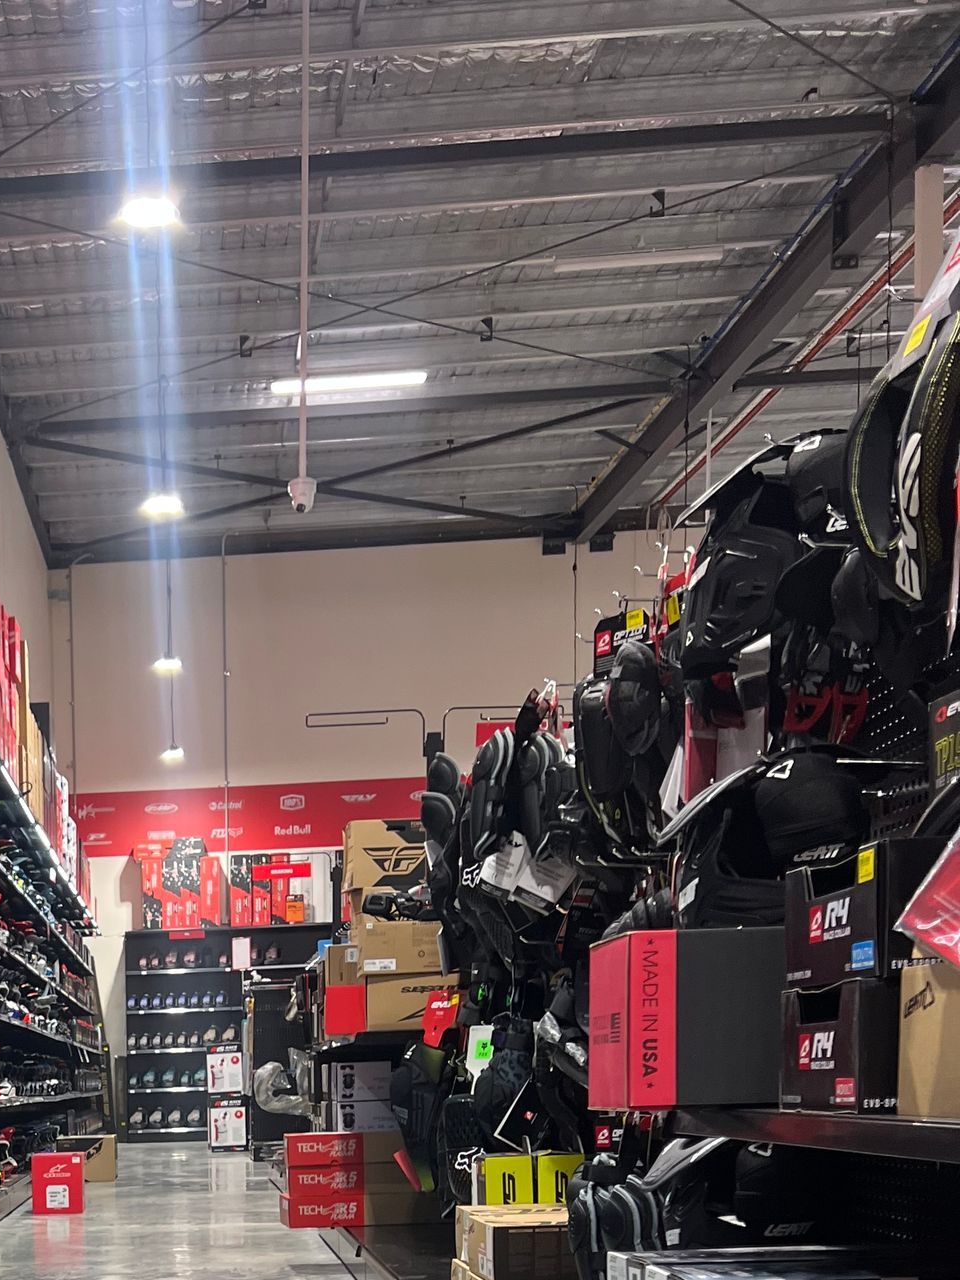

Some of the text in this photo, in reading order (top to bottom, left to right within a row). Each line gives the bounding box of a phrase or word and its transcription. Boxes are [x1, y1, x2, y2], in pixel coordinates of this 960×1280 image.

[274, 824, 311, 836] Red Bull
[824, 896, 851, 930] R4
[642, 950, 658, 1078] MADE IN USA
[811, 1031, 835, 1059] R4
